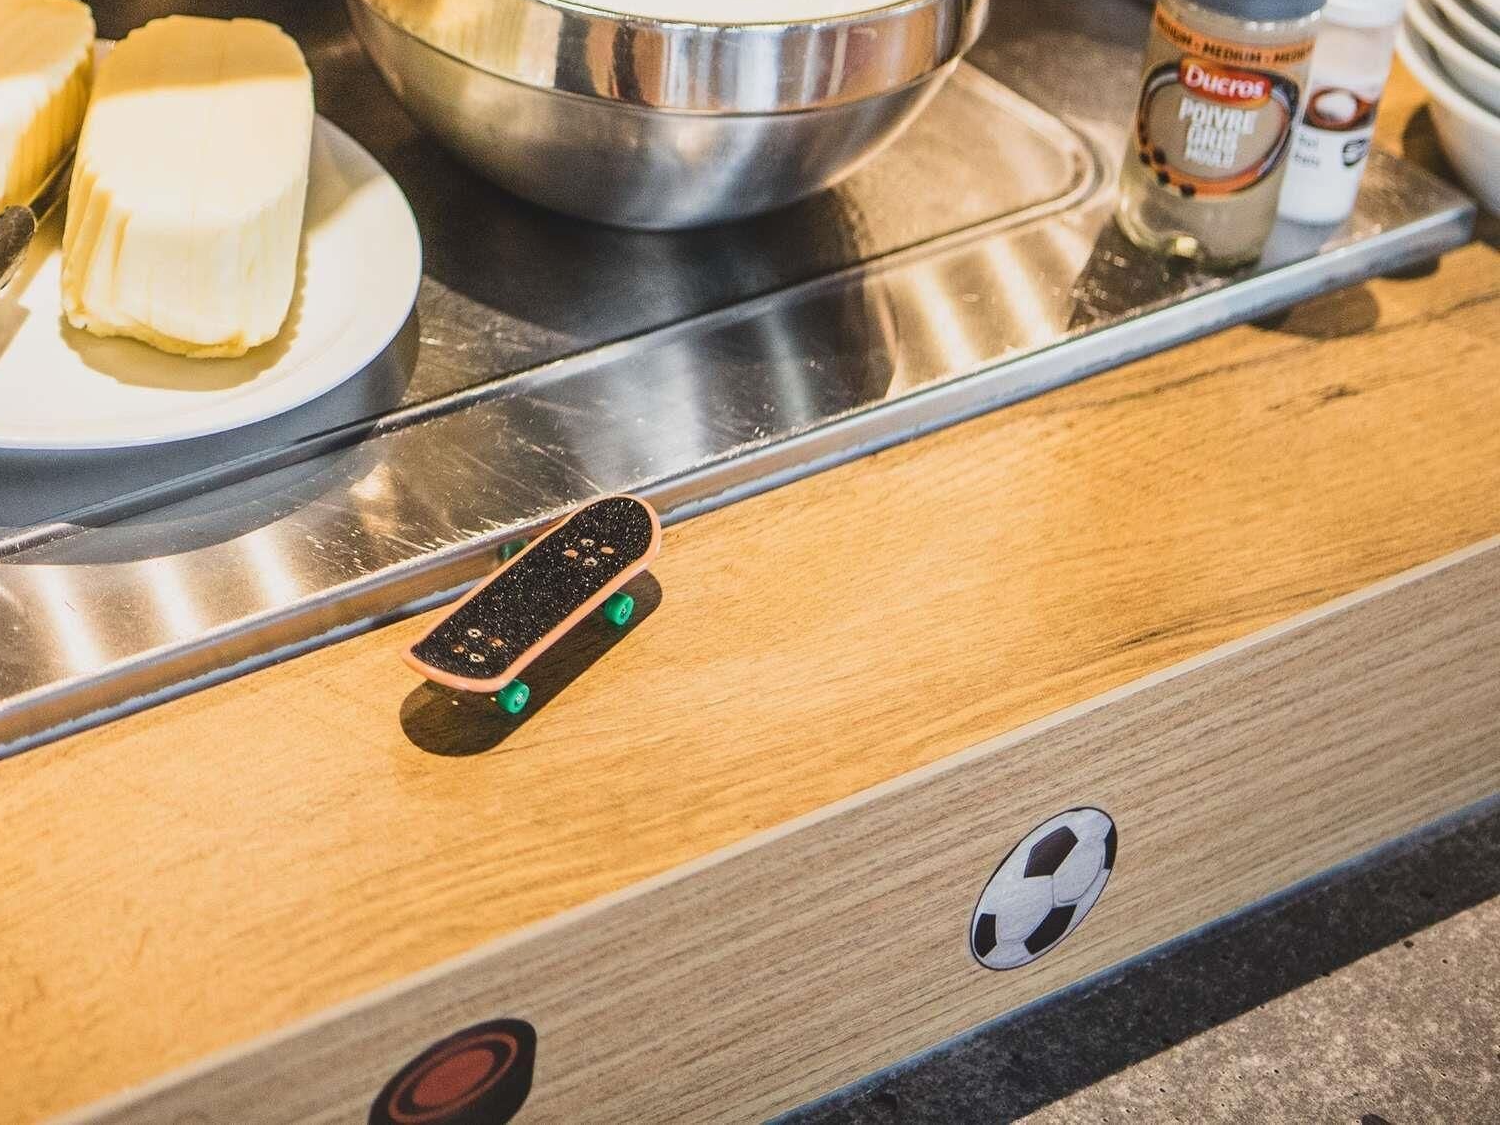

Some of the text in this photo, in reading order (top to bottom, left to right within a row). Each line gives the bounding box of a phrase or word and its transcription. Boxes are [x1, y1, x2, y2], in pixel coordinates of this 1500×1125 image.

[1203, 42, 1261, 63] MEDIUM
[1185, 64, 1266, 100] Ducros
[1179, 97, 1259, 134] POIVRE
